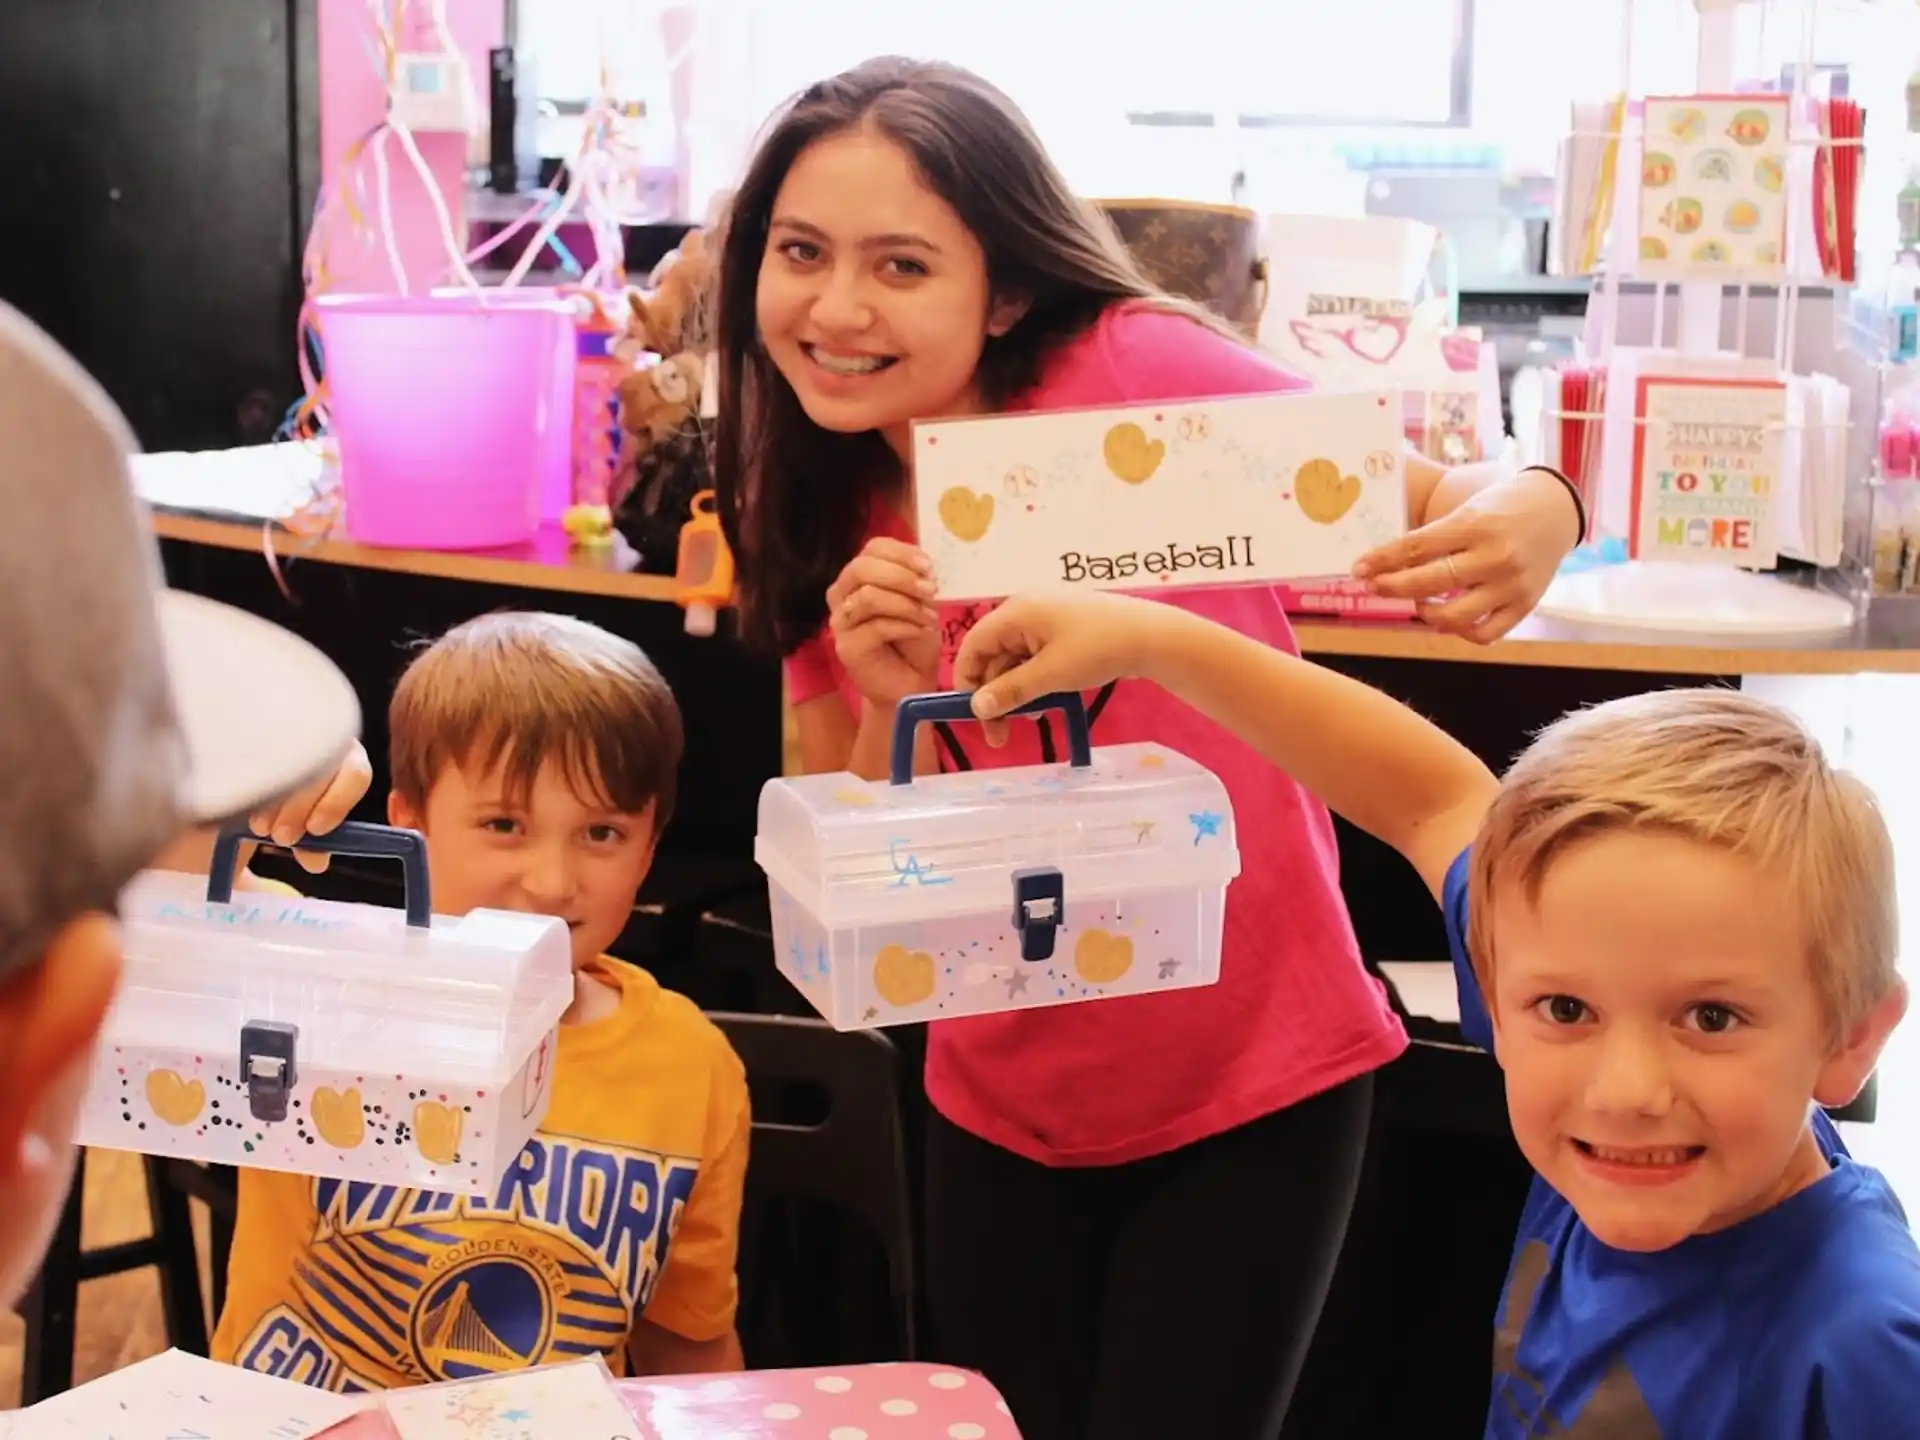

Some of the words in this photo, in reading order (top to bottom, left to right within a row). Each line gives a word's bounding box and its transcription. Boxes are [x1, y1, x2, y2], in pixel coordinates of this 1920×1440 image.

[1657, 471, 1698, 492] TO
[1708, 473, 1770, 495] YOU
[1059, 536, 1256, 583] Baseball
[430, 1238, 521, 1272] GOLDEN
[526, 1246, 568, 1297] STATE
